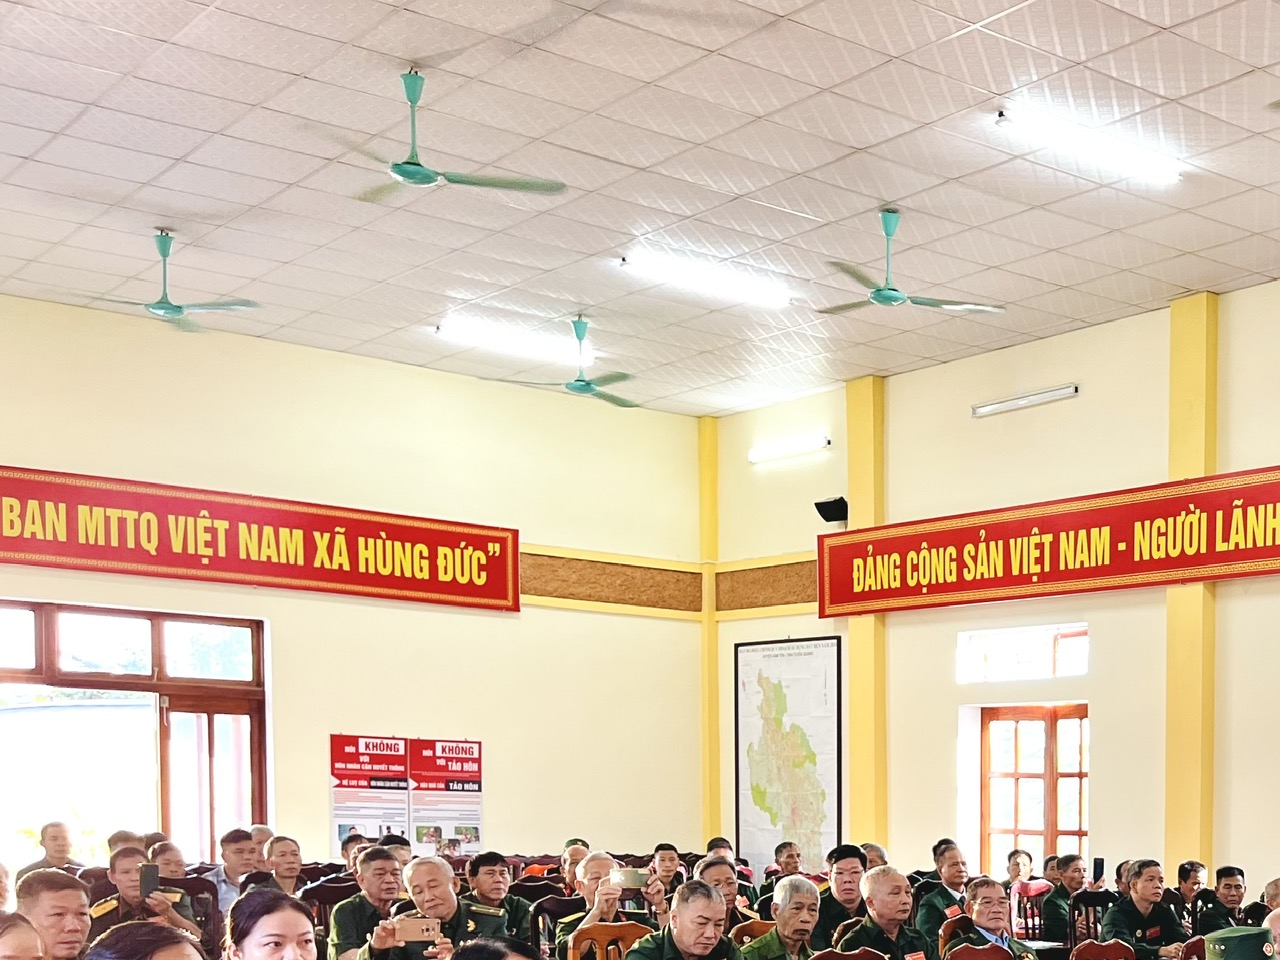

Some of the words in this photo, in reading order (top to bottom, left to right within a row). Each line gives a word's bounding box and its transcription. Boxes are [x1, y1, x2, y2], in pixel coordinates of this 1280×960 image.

[2, 496, 67, 542] BAN
[78, 505, 159, 555] MTTQ
[168, 511, 229, 564] VIỆT
[239, 523, 304, 566] NAM
[313, 527, 351, 571] XÃ
[358, 530, 430, 580] HÙNG
[853, 545, 901, 592] ĐẢNG
[907, 542, 957, 594] CỘNG
[964, 529, 1004, 581] SẢN
[1009, 527, 1053, 582] VIỆT
[1059, 526, 1111, 570] NAM
[1133, 504, 1207, 561] NGƯỜI
[365, 740, 400, 753] KHÔNG
[441, 743, 474, 756] KHÔNG
